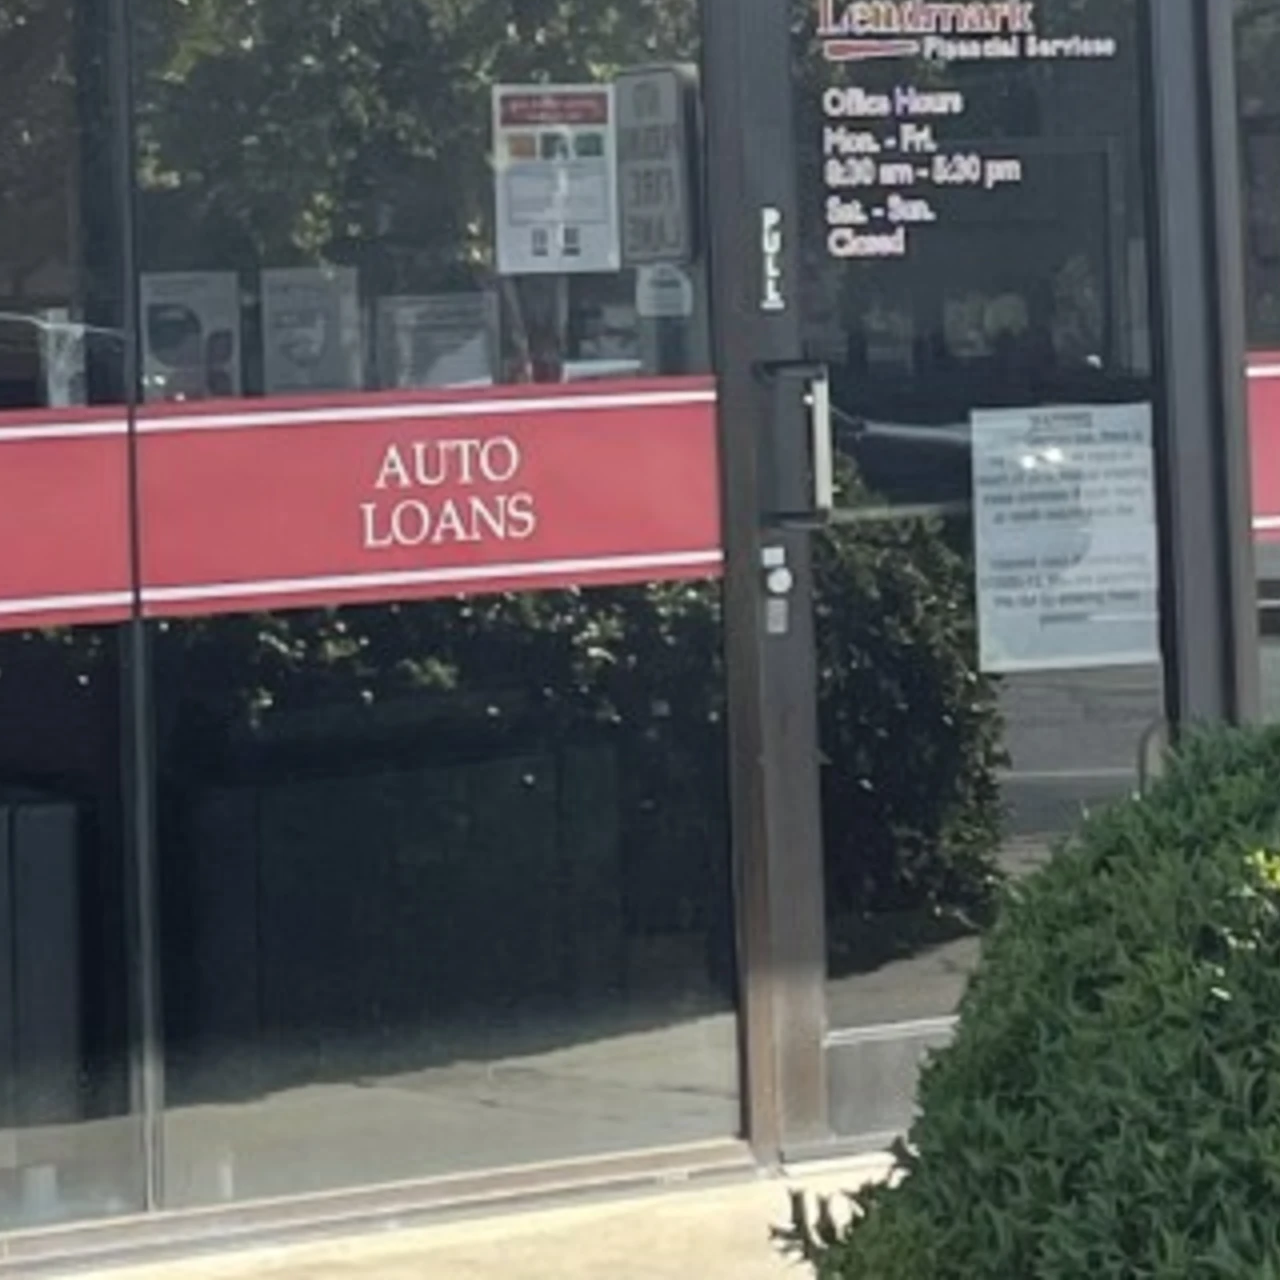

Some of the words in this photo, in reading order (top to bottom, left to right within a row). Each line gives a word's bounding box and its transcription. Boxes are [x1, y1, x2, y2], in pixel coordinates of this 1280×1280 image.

[923, 35, 1019, 60] Financial
[1026, 35, 1115, 58] Services
[823, 87, 890, 117] Office
[894, 86, 963, 116] Hours
[823, 125, 880, 155] Mon.
[900, 123, 938, 153] Fri.
[879, 163, 913, 185] am
[984, 159, 1021, 190] pm
[761, 207, 781, 301] PULL
[827, 226, 905, 257] Closed
[375, 436, 519, 489] AUTO
[360, 492, 536, 549] LOANS
